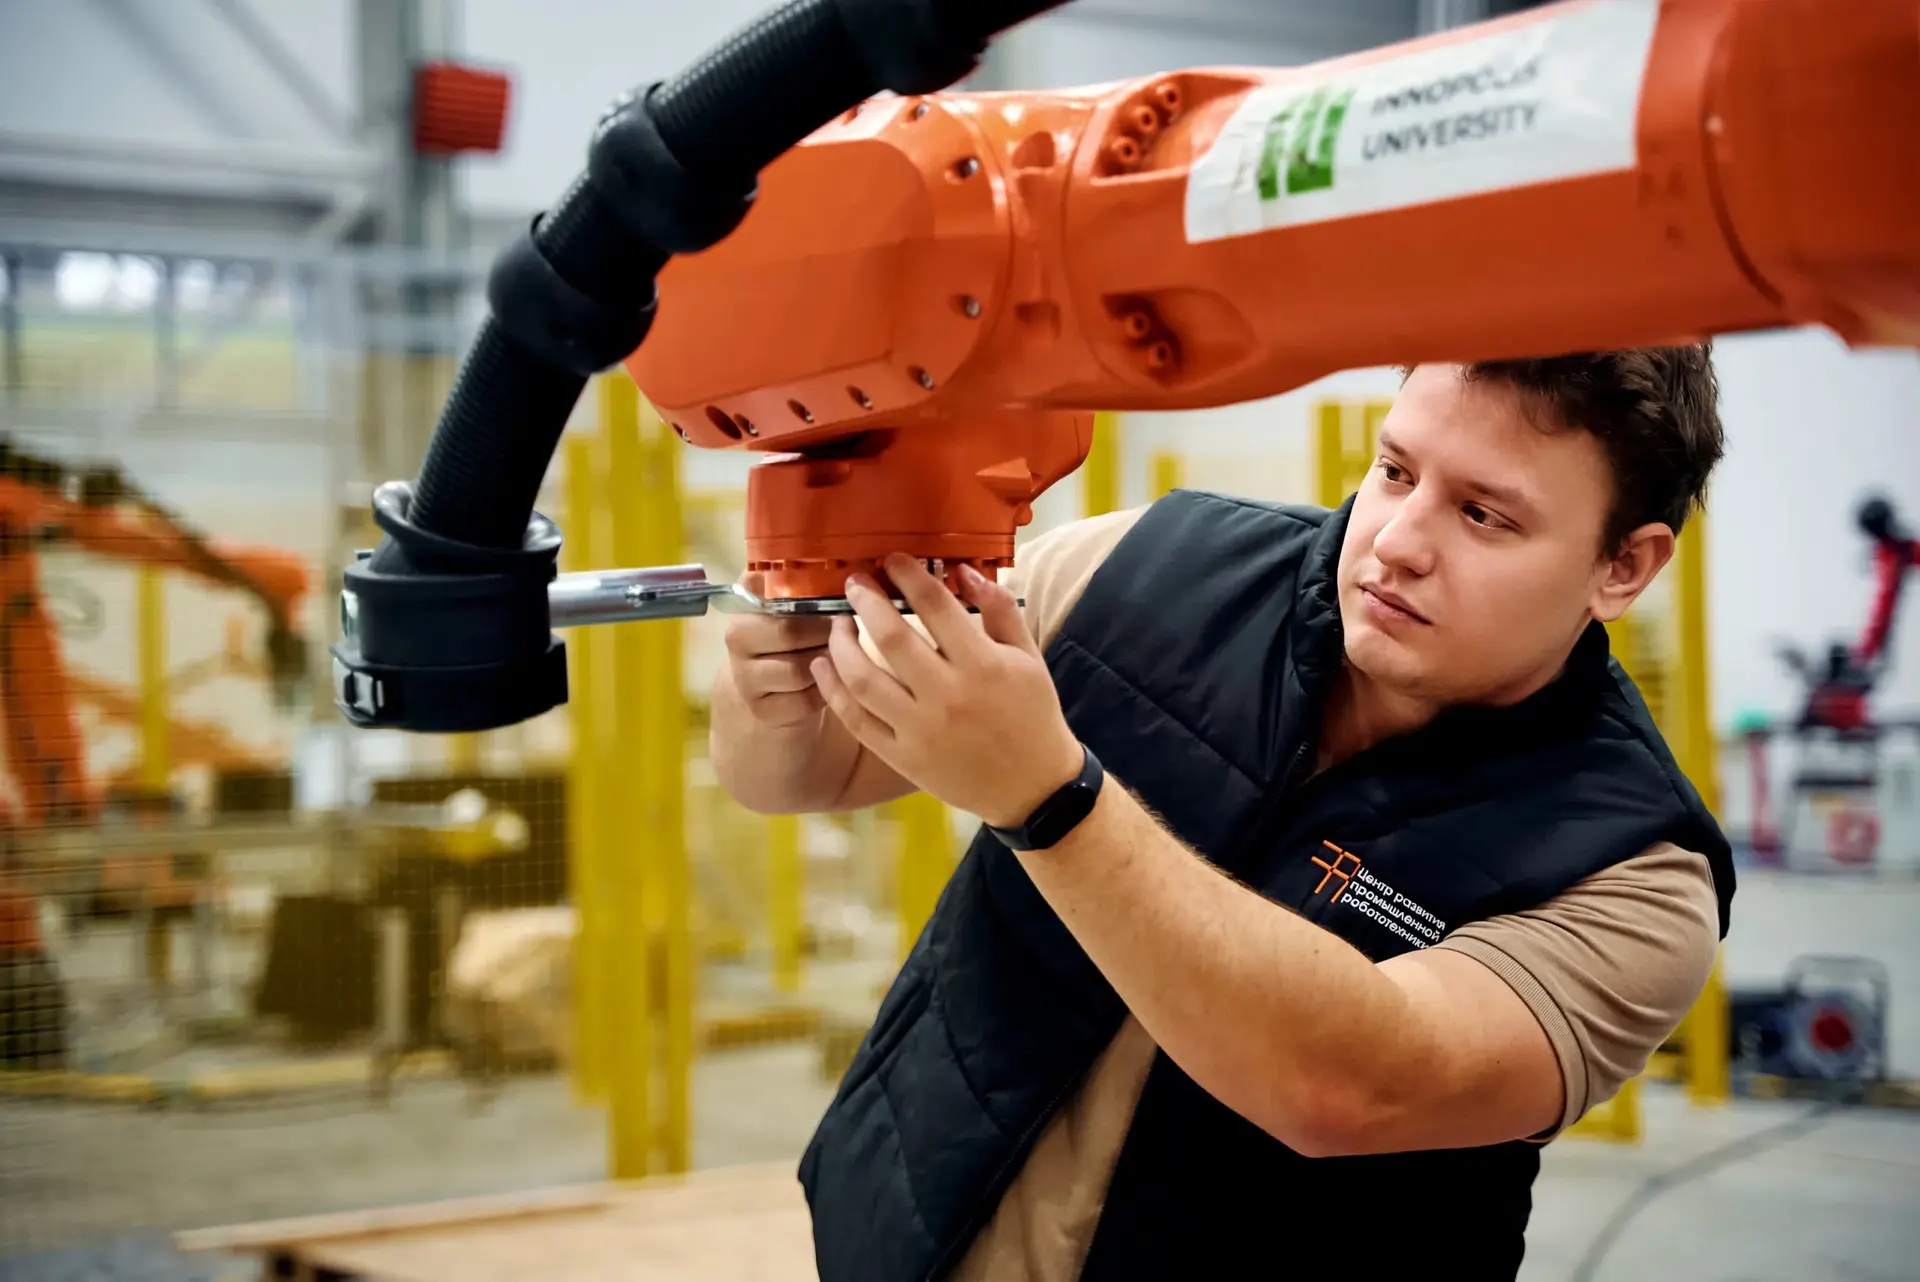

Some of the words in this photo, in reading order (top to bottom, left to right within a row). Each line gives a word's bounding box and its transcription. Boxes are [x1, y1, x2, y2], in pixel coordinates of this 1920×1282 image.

[1362, 101, 1540, 161] UNIVERSITY
[1350, 881, 1440, 942] промышленной
[1357, 867, 1394, 896] Центр
[1394, 893, 1446, 930] развития
